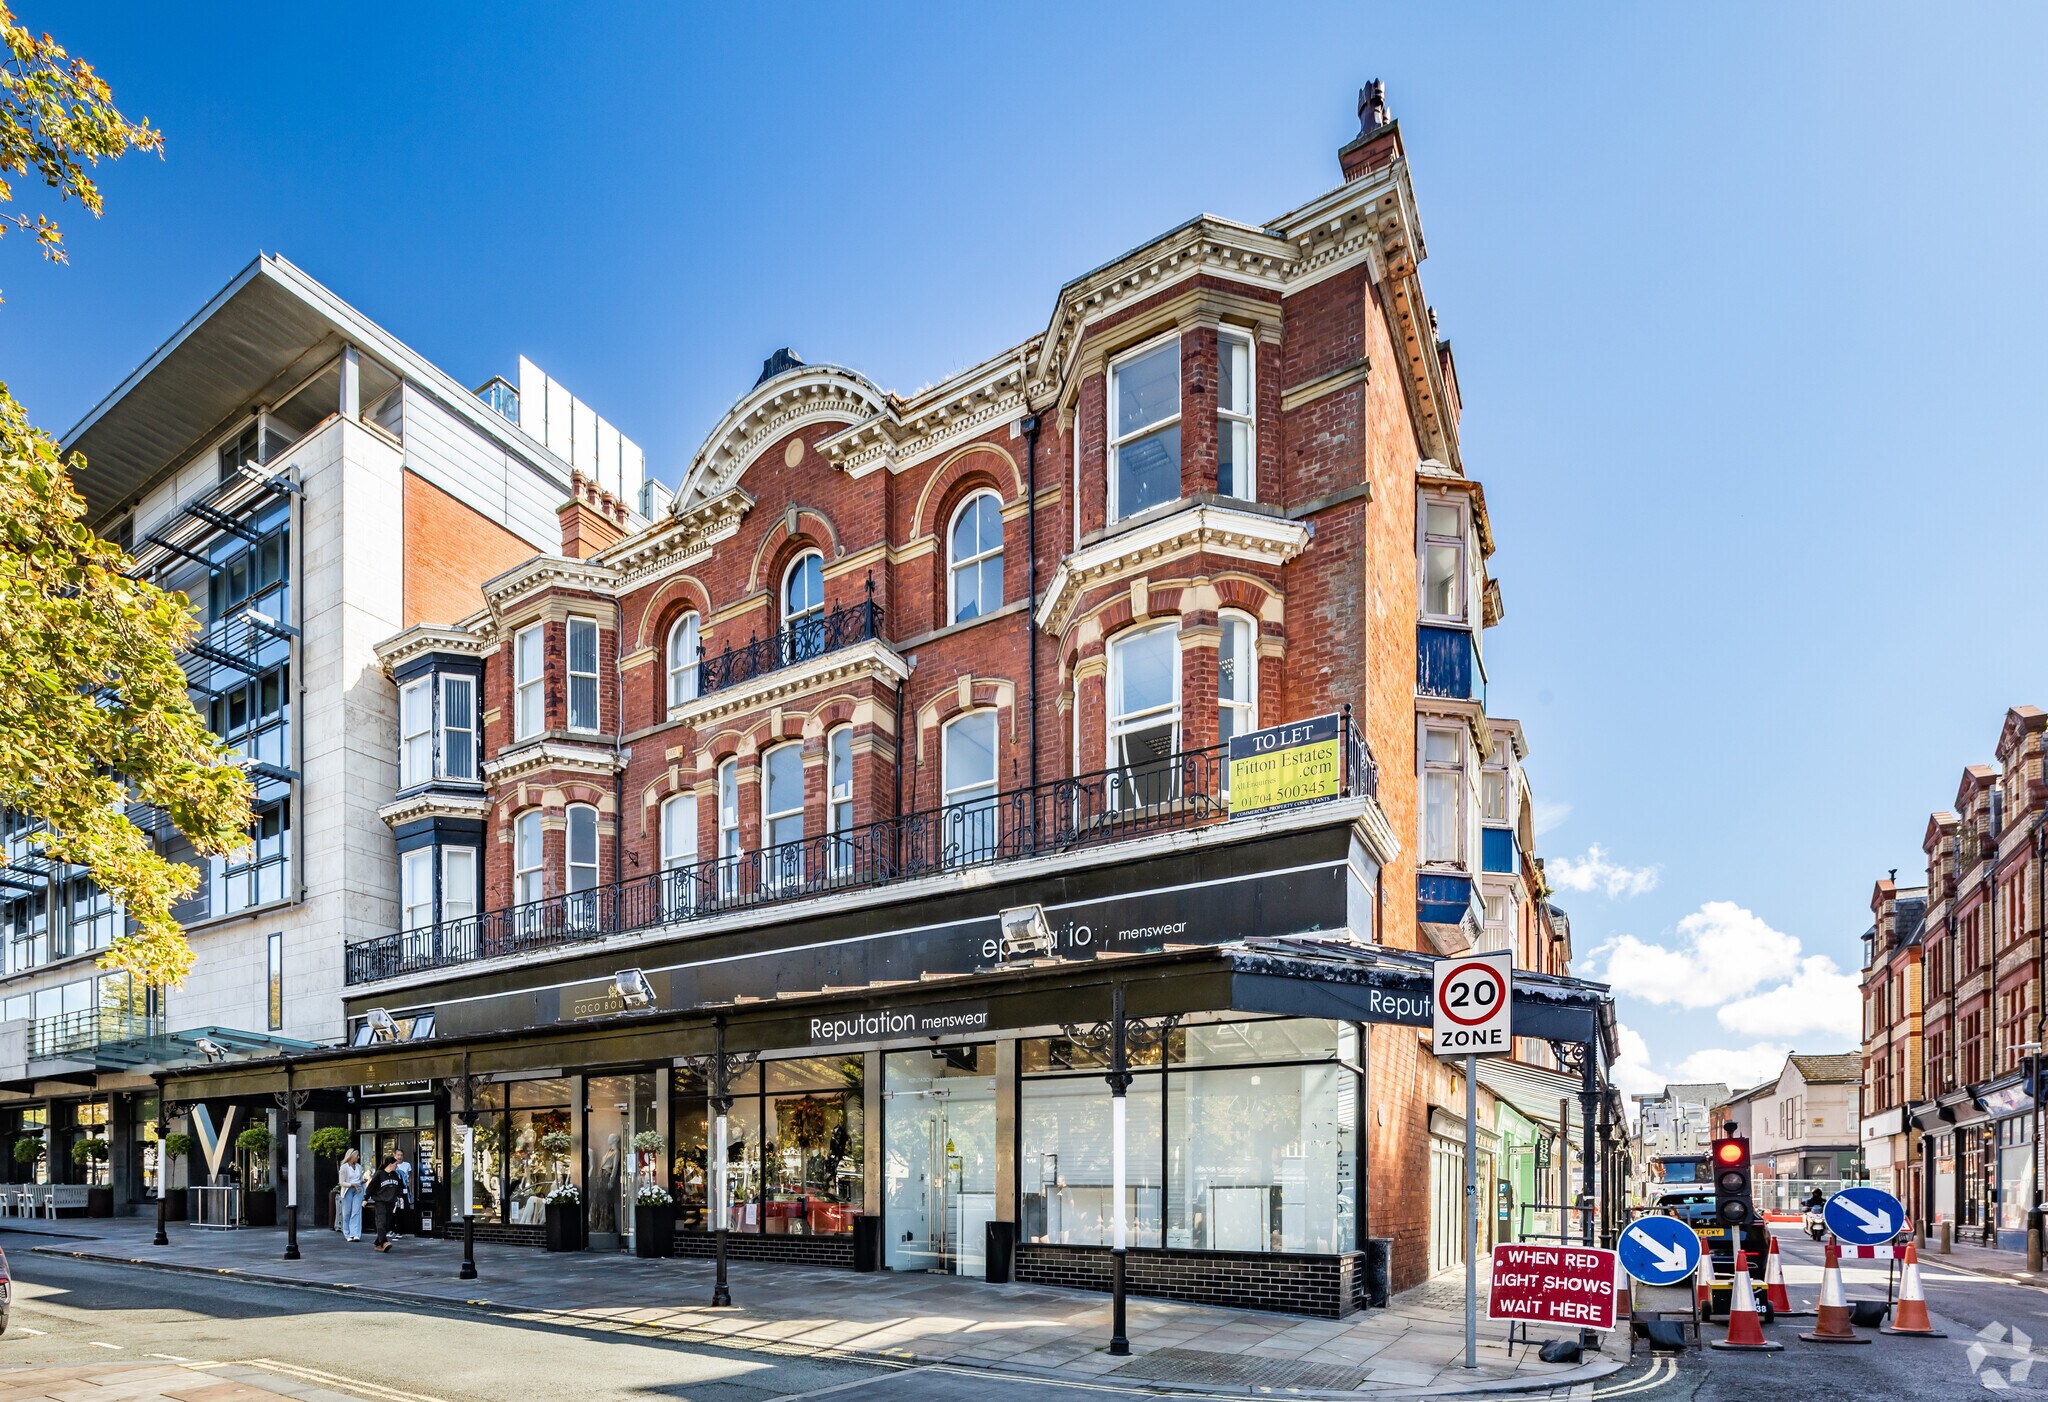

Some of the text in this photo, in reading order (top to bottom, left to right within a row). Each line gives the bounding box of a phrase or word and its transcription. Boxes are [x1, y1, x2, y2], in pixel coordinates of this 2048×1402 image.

[1252, 724, 1314, 752] TO LET
[1235, 745, 1333, 777] Fitton Estates
[1298, 761, 1332, 778] .com
[1235, 776, 1277, 791] All Enquiries
[1241, 780, 1326, 808] 01704 500345
[1236, 795, 1331, 818] COMMERCIAL PROPERTY CONSULTANTS
[1118, 921, 1187, 941] menswear
[1370, 989, 1434, 1020] Reput
[1450, 980, 1496, 1008] 20
[574, 1002, 600, 1015] COCO
[810, 1010, 988, 1042] Reputation menswear
[1441, 1029, 1502, 1047] ZONE
[1508, 1250, 1599, 1269] WHEN RED
[1493, 1273, 1612, 1295] LIGHT SHOWS
[1500, 1299, 1602, 1322] WAIT HERE
